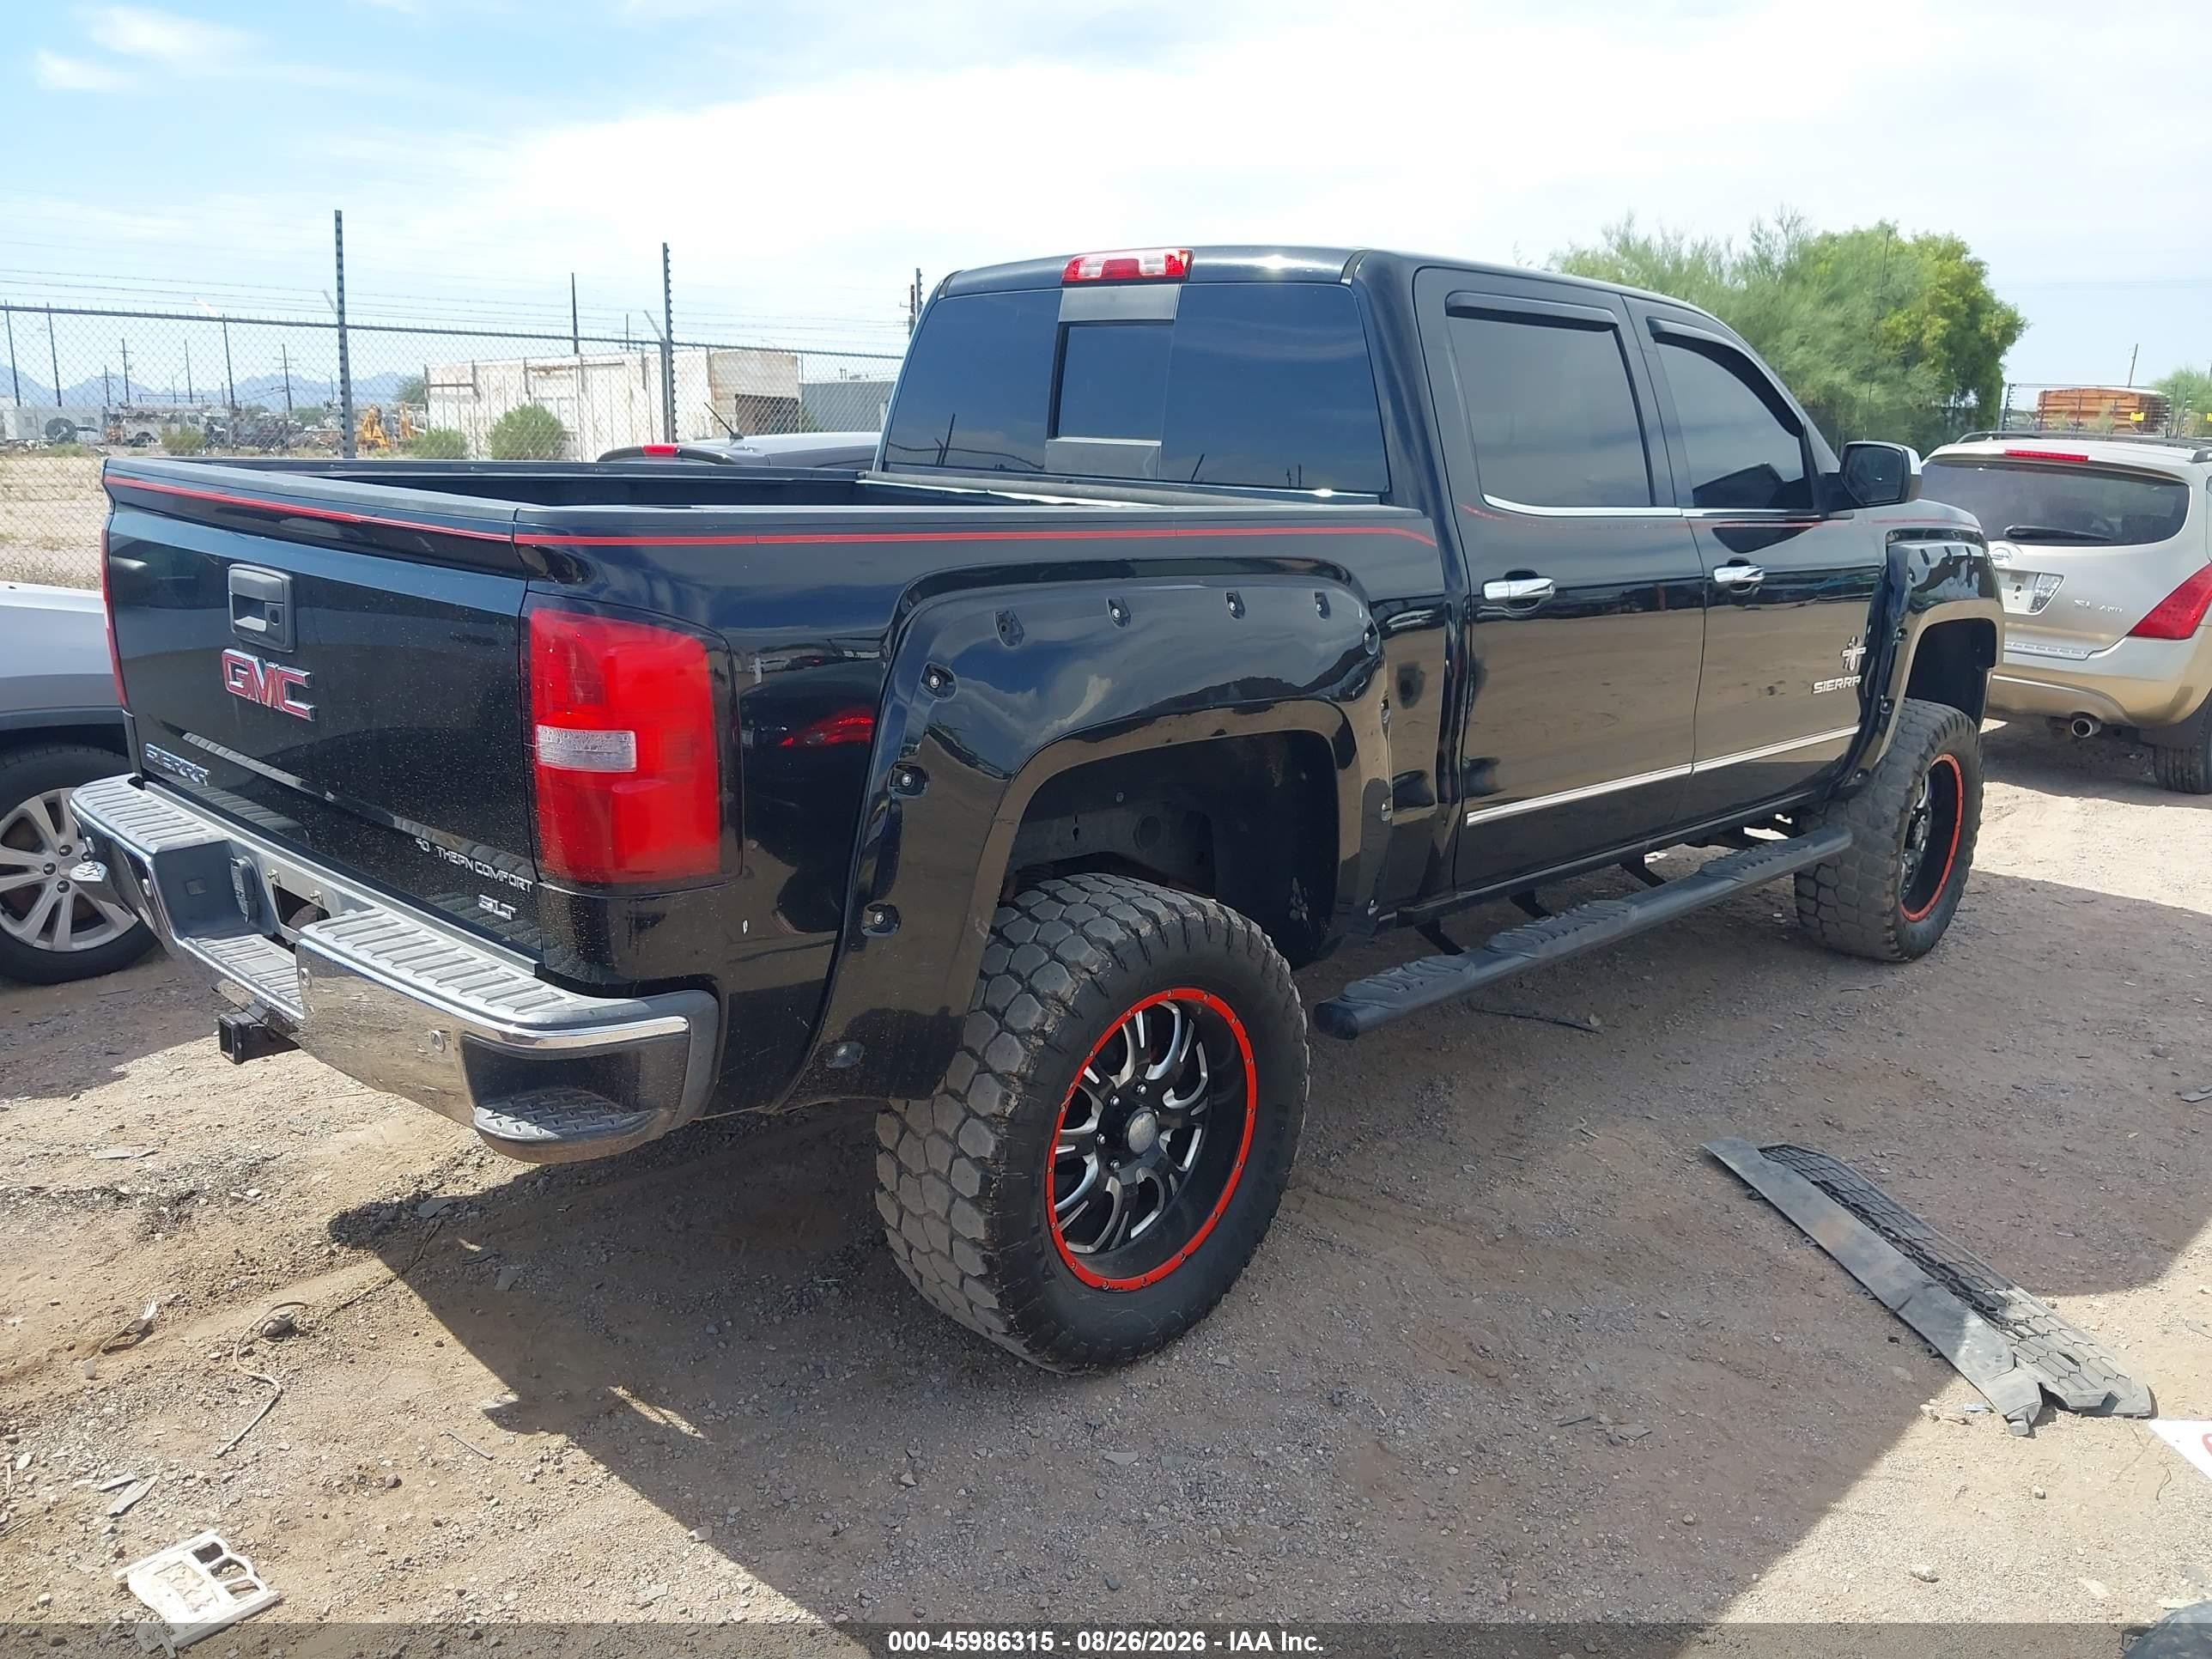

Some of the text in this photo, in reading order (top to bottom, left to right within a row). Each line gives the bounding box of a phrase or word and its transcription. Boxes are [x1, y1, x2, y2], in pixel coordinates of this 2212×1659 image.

[222, 648, 315, 721] GMC
[1813, 675, 1862, 694] SIERRA
[475, 861, 533, 893] COMFORT
[478, 894, 517, 921] SLT
